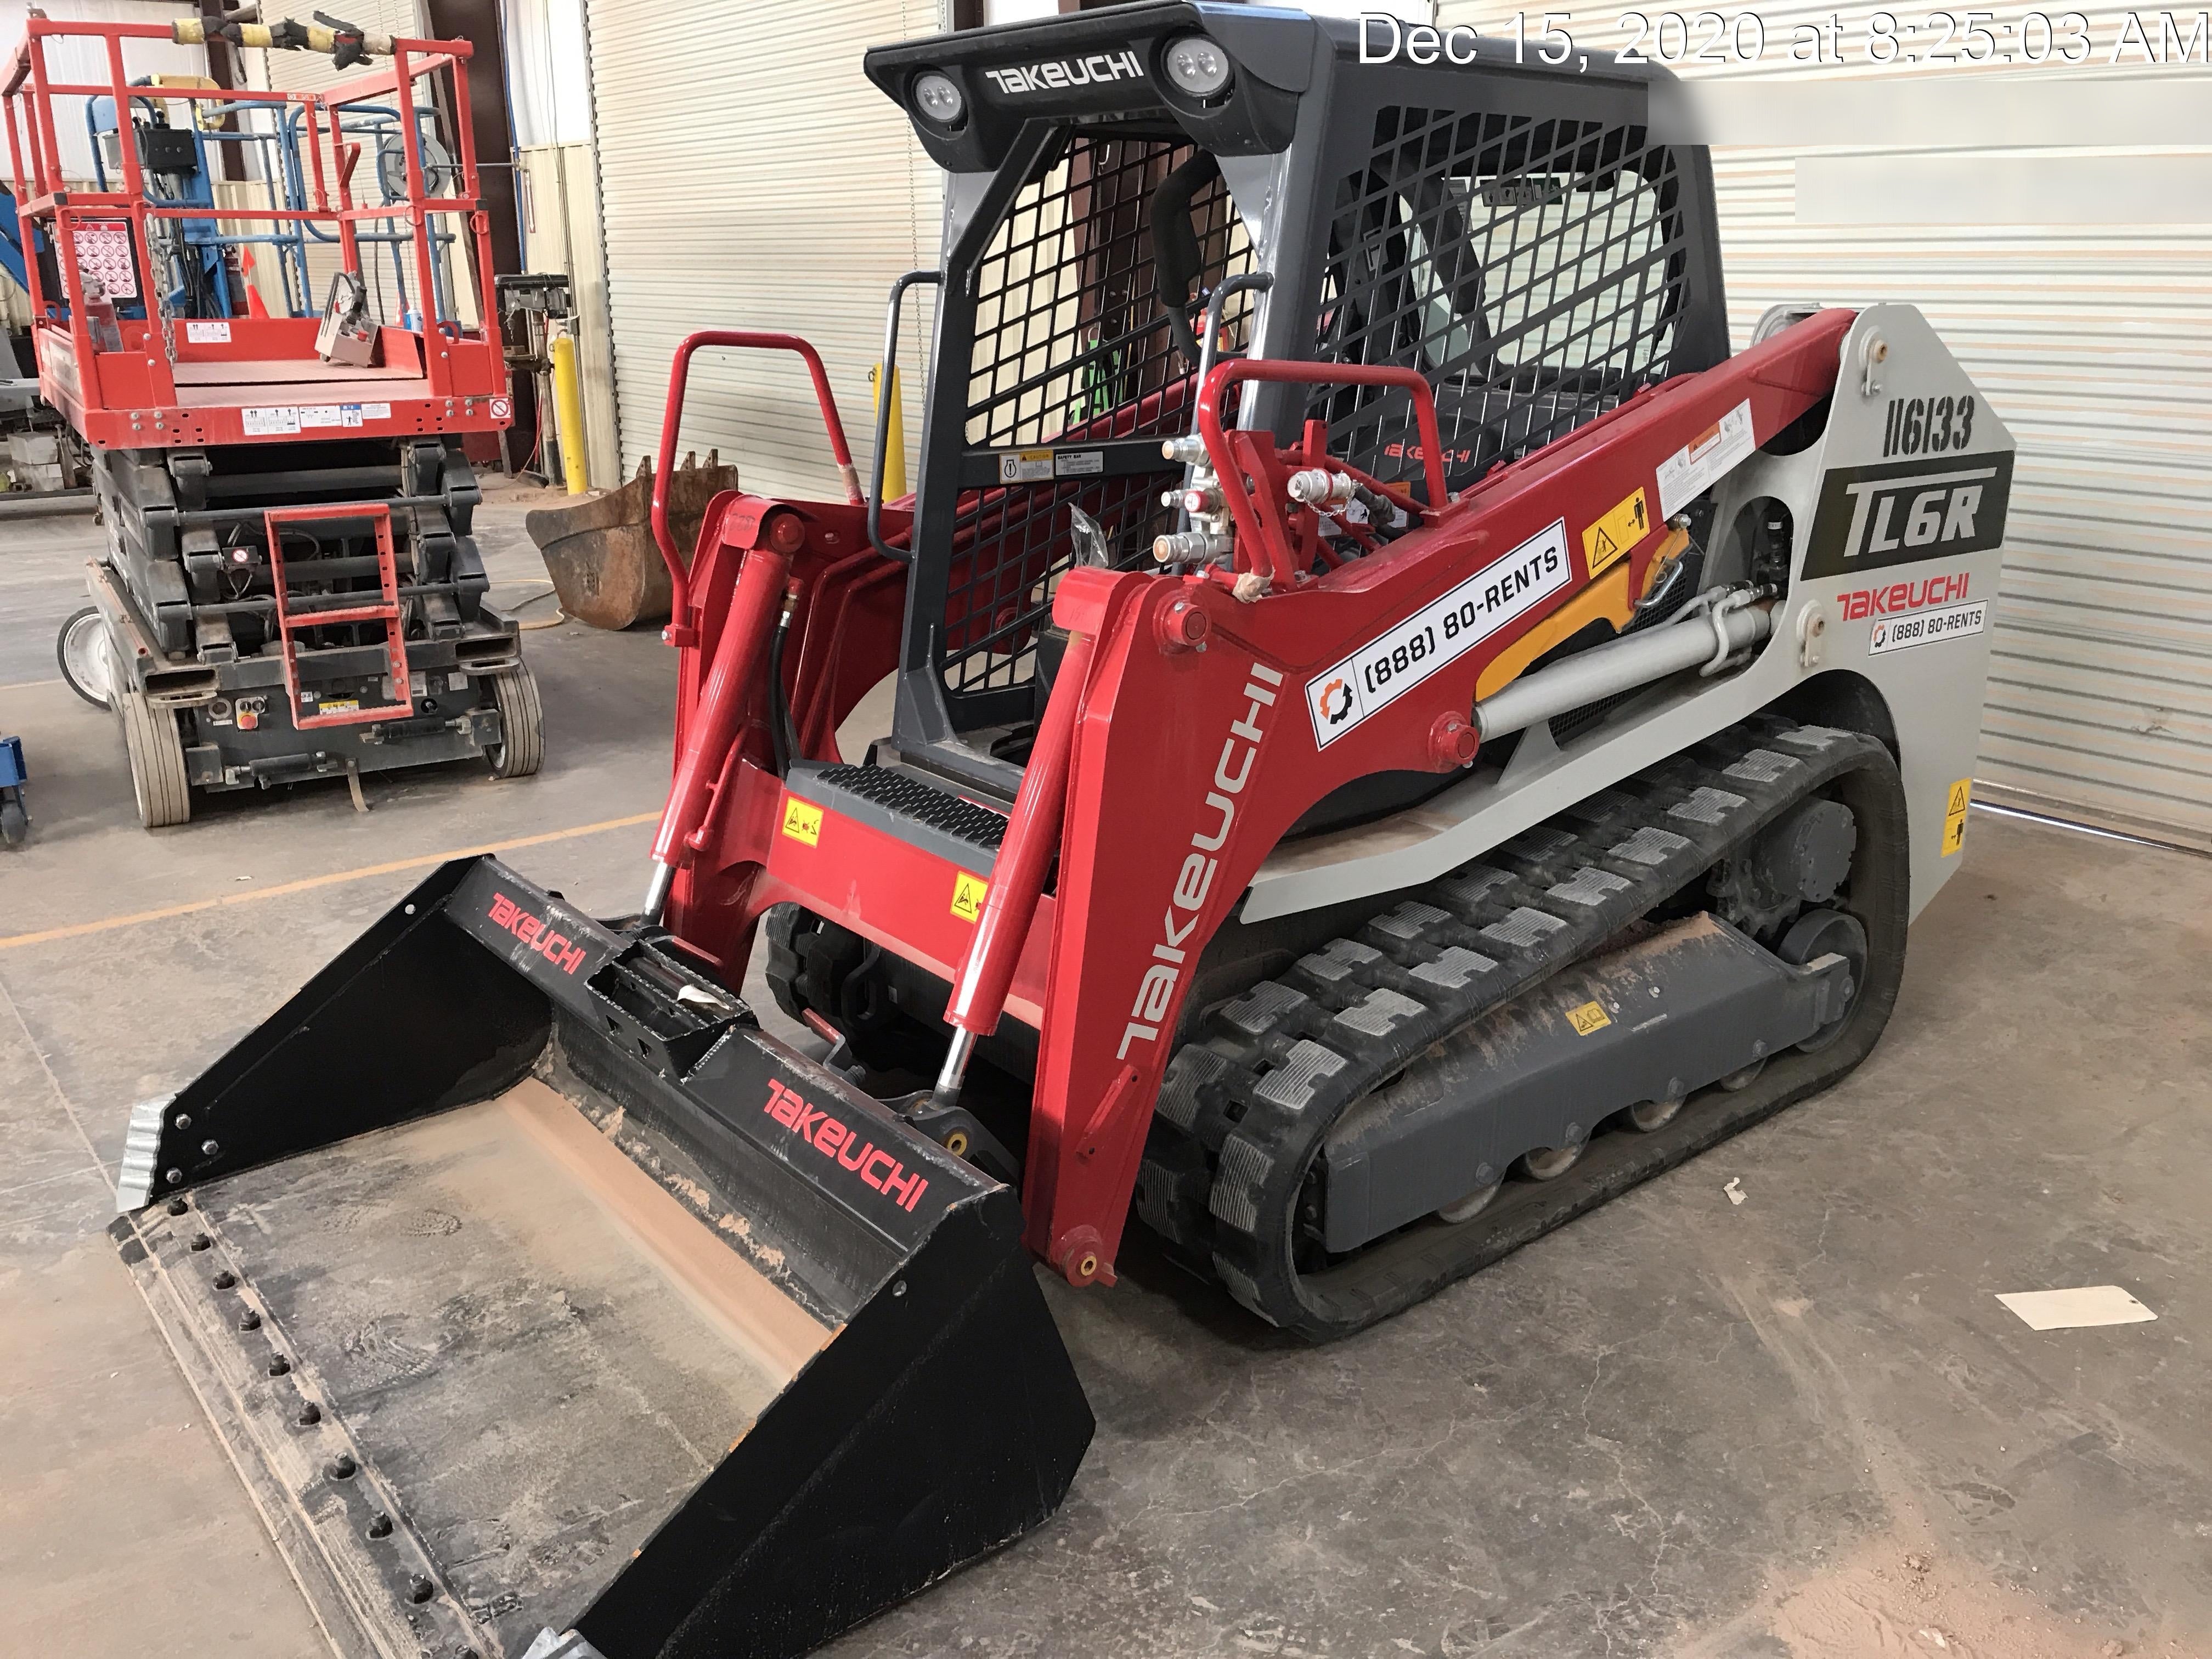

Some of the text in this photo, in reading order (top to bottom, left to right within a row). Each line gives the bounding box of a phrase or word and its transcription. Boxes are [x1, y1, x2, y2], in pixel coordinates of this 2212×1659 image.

[985, 51, 1144, 94] TAKEUCHI
[1883, 395, 1974, 457] 116133
[1844, 466, 1997, 556] TL6R
[1364, 546, 1558, 693] (888) 80-RENTS
[1837, 572, 1970, 621] TAKEUCHI
[1892, 610, 1982, 642] (888) 80-RENTS
[1116, 662, 1283, 1060] TAKEUCHI
[488, 892, 586, 974] TAKEUCHI
[764, 1079, 929, 1212] TAKEUCHI
